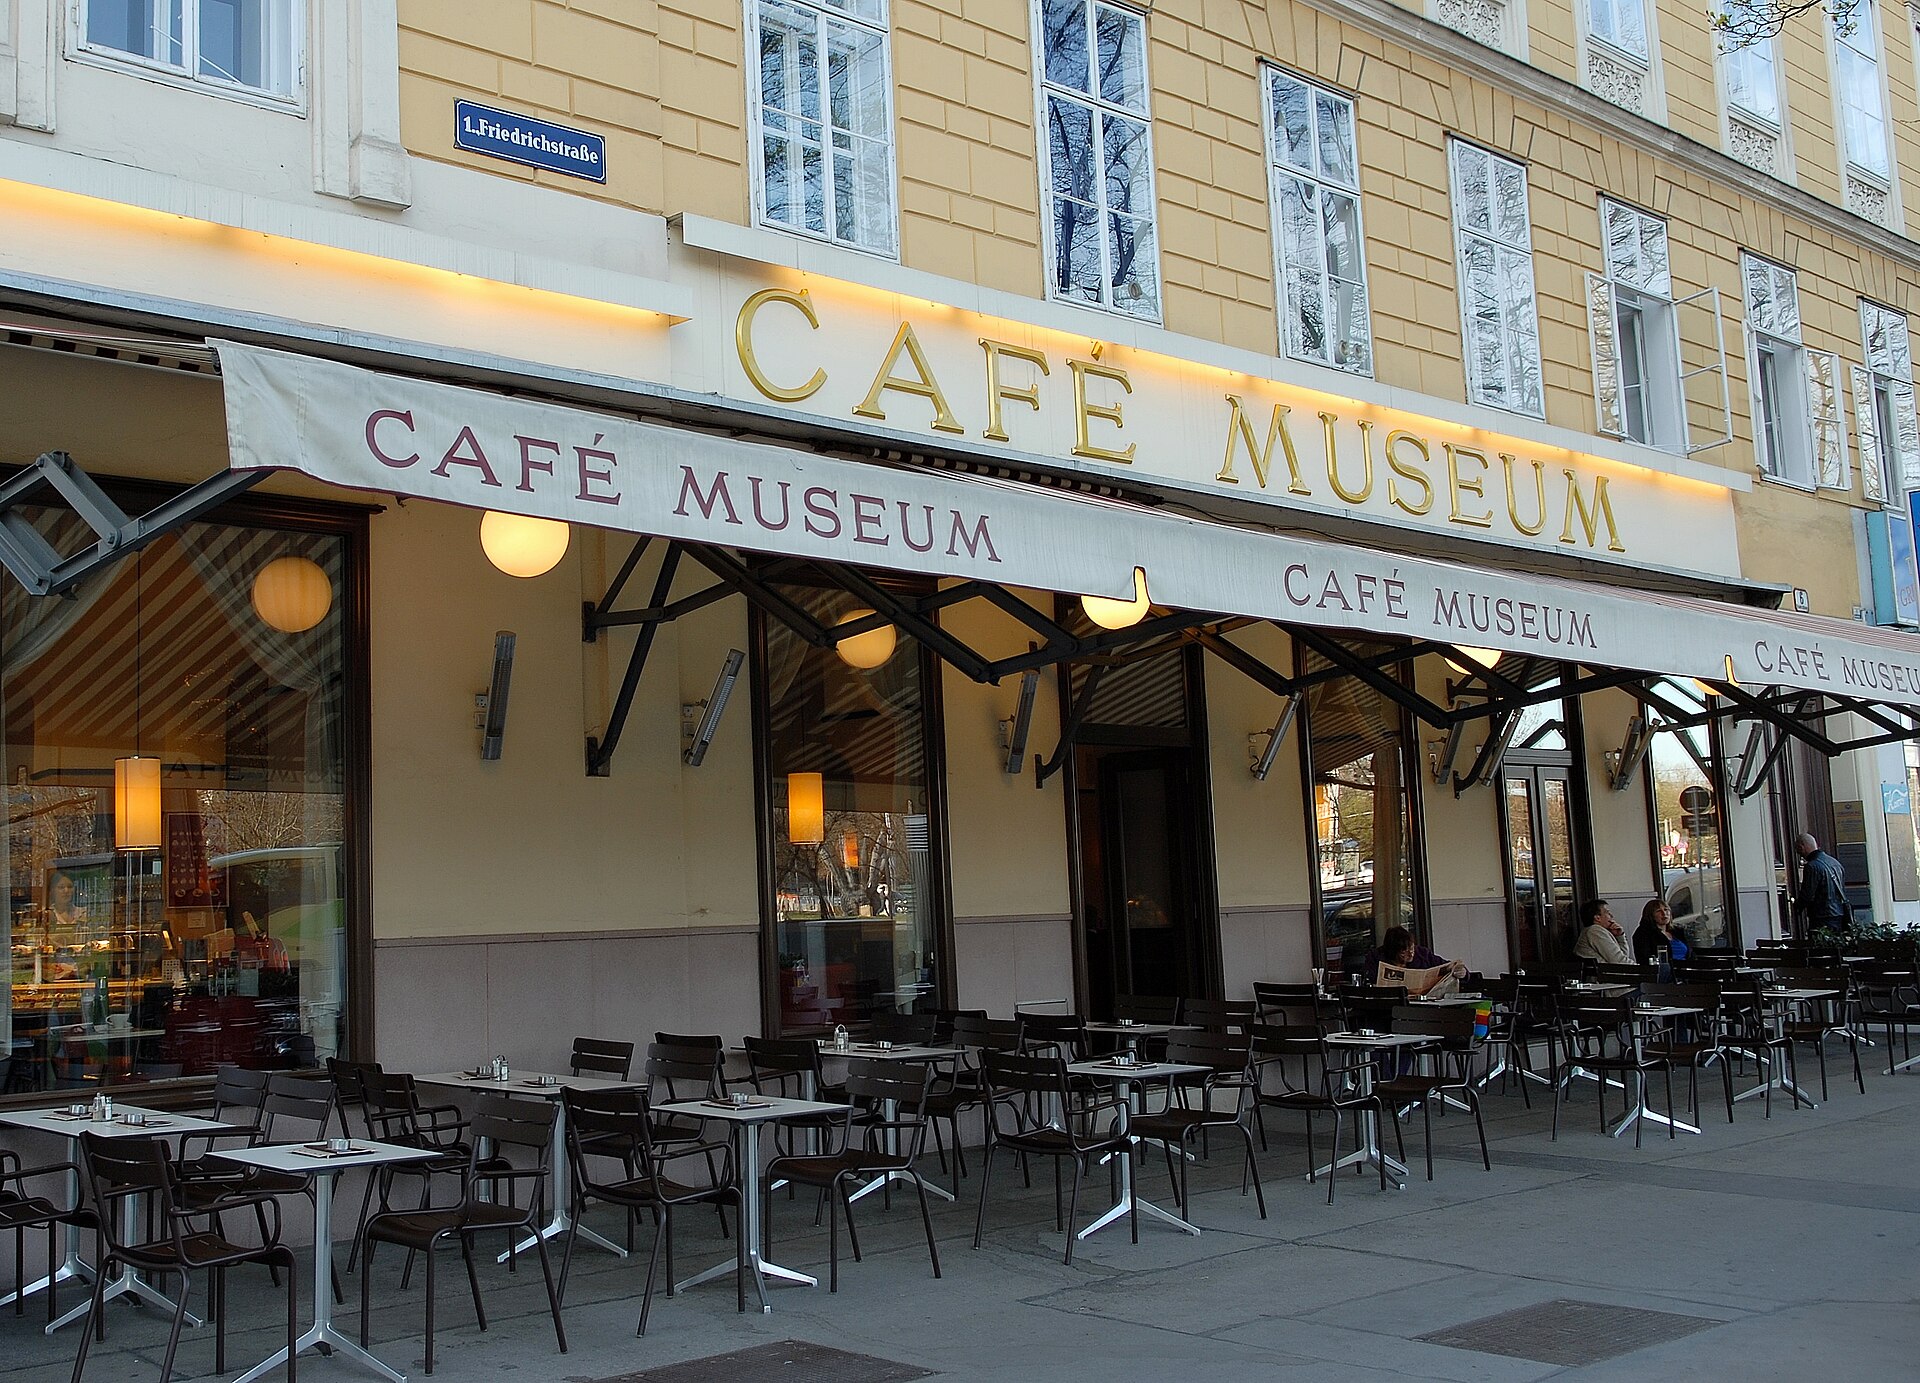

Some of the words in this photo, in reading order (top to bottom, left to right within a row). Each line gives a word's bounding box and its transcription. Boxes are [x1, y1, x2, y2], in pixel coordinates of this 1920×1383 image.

[735, 288, 1138, 465] CAFÉ
[1214, 393, 1627, 554] MUSEUM
[365, 409, 622, 505] CAFÉ
[673, 465, 1003, 563] MUSEUM
[1283, 563, 1410, 619] CAFÉ
[1432, 588, 1599, 649] MUSEUM
[1754, 641, 1831, 682] CAFÉ
